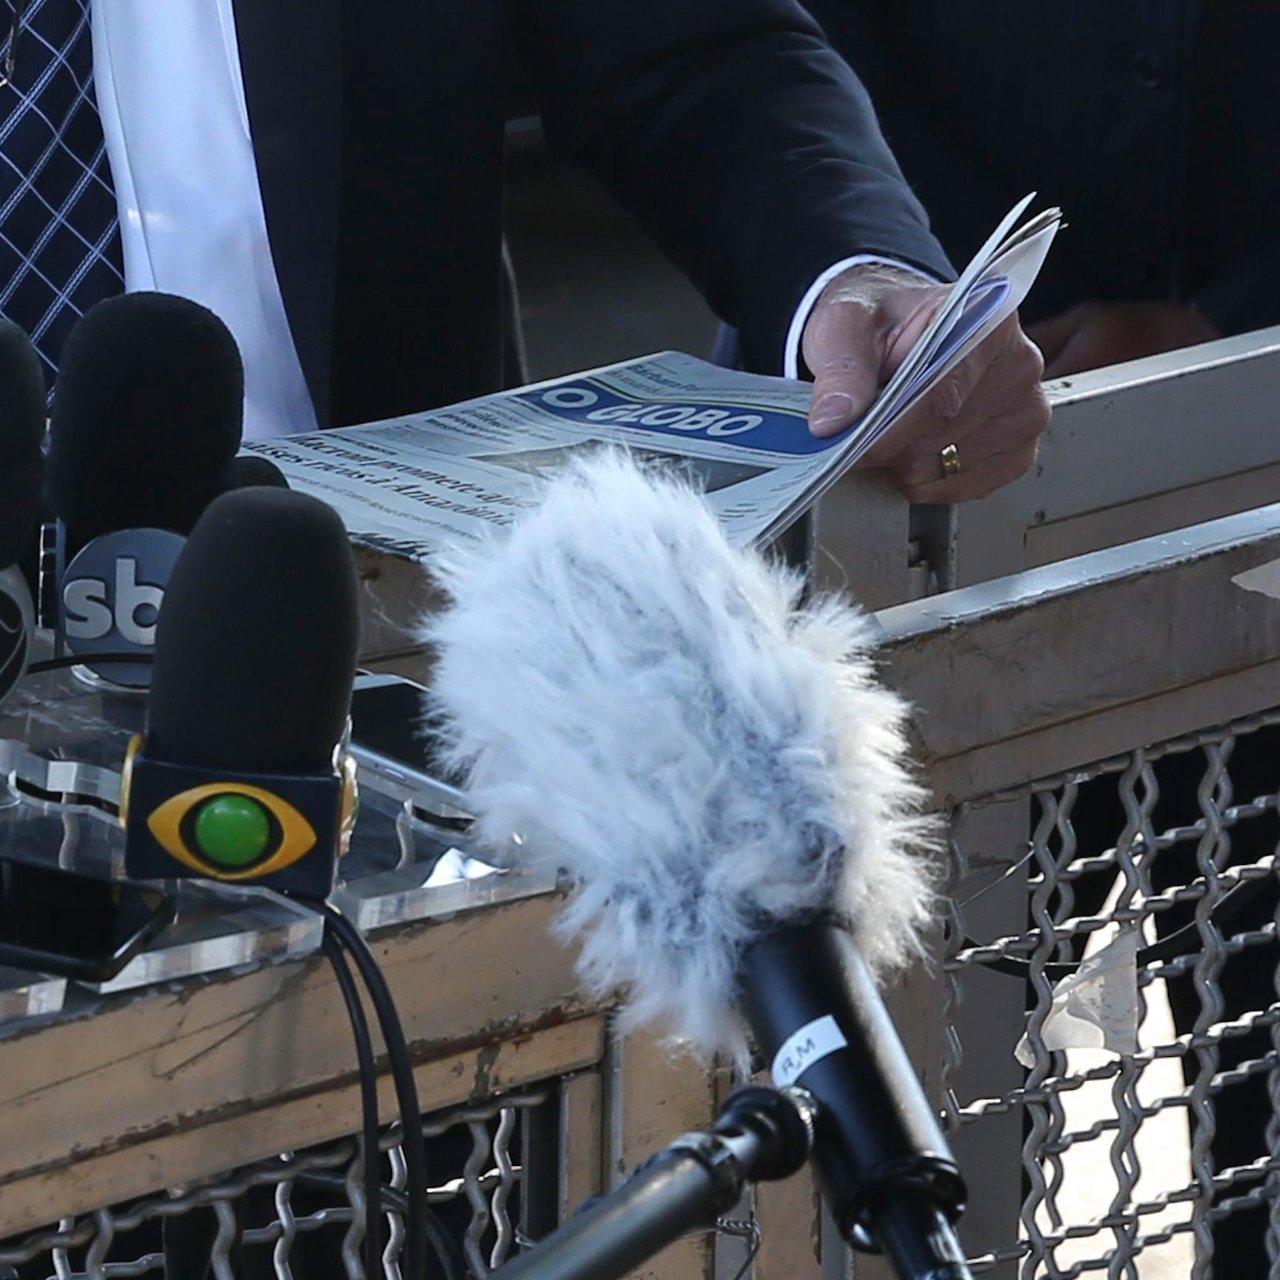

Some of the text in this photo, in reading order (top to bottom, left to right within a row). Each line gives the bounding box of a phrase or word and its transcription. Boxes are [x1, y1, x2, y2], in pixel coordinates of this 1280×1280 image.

[542, 387, 598, 408] O
[586, 404, 764, 437] GLOBO
[63, 557, 165, 646] sb
